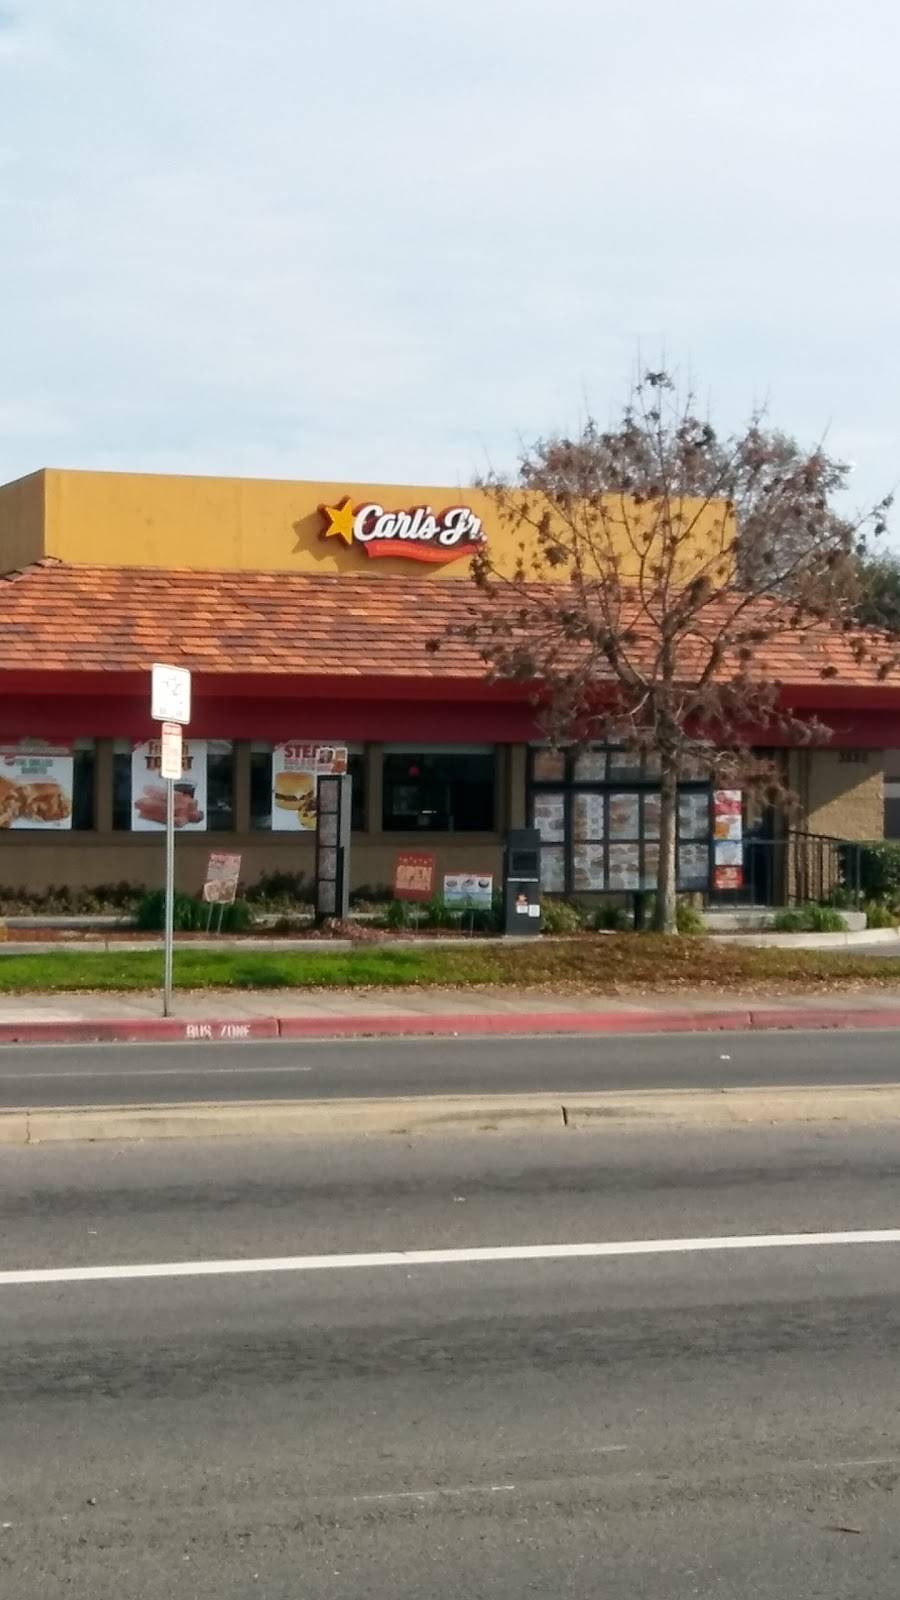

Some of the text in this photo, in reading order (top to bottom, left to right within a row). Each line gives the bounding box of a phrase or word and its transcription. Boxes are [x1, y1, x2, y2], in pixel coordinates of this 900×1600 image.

[353, 504, 440, 542] Carl's
[186, 1024, 251, 1039] BUS ZONE
